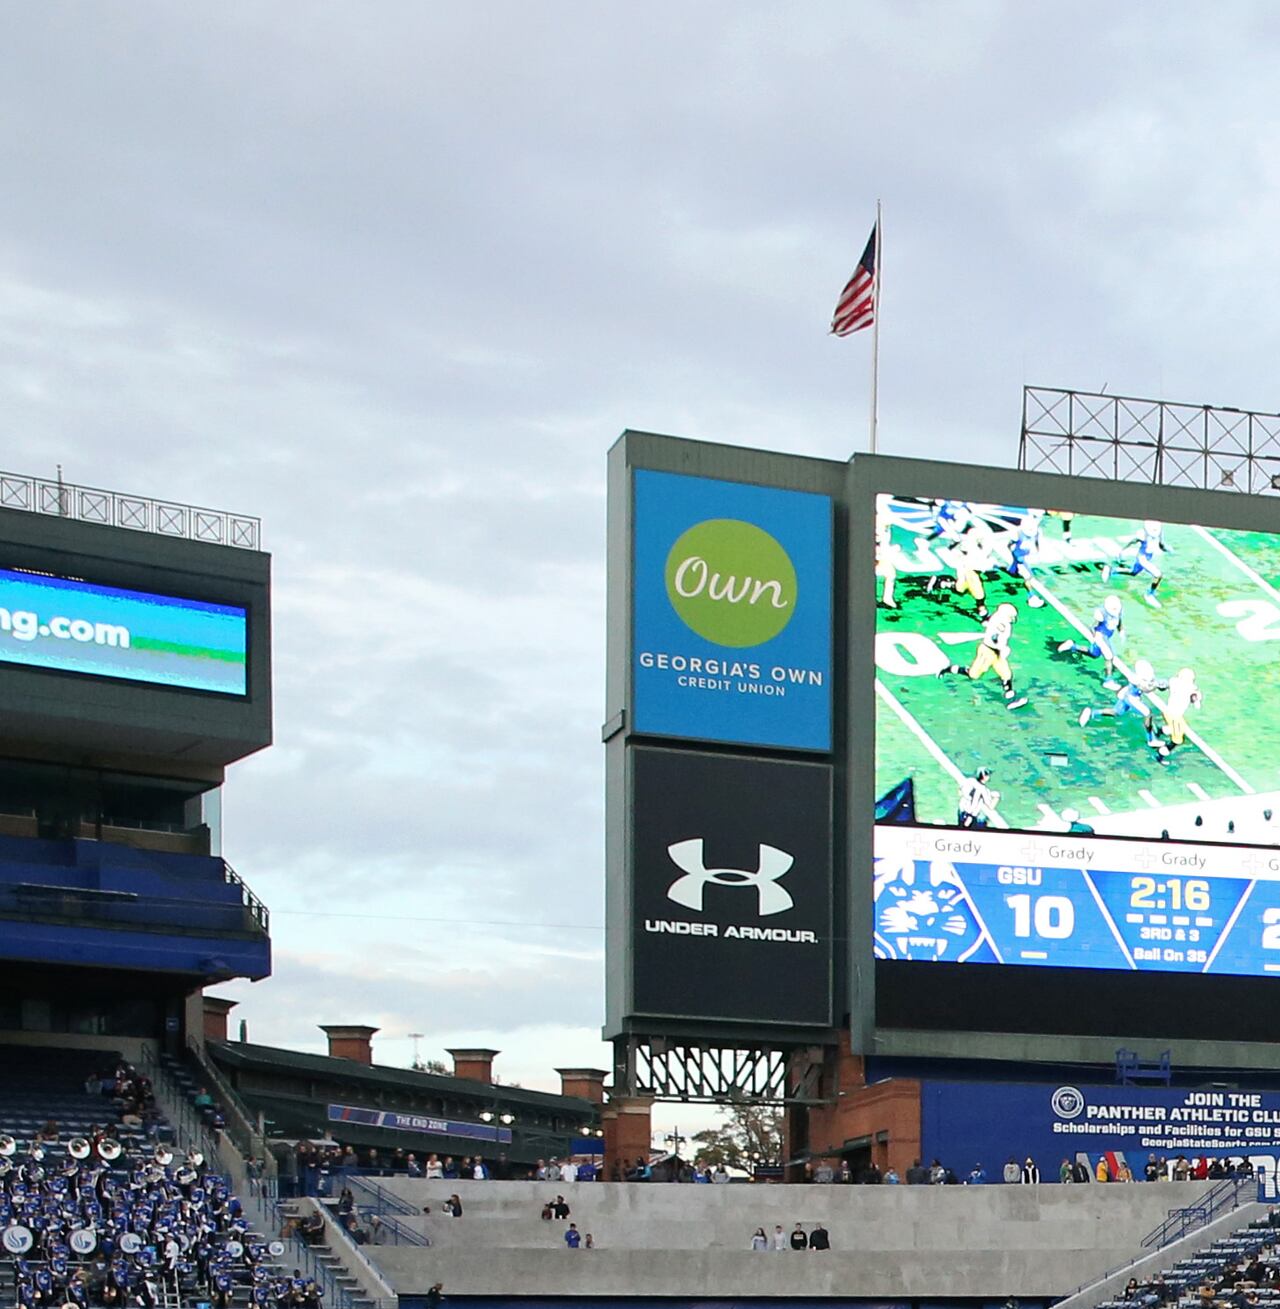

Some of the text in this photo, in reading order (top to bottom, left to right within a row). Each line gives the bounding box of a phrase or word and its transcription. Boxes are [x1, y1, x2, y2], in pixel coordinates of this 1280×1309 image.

[675, 556, 789, 608] Own
[640, 653, 823, 686] GEORGIA'S OWN
[678, 676, 785, 697] CREDIT UNION
[934, 838, 982, 857] Grady
[1048, 845, 1096, 863] Grady
[1161, 851, 1207, 870] Grady
[996, 866, 1042, 887] GSU
[1129, 876, 1211, 911] 2:16
[1006, 893, 1075, 939] 10
[645, 919, 718, 938] UNDER
[1140, 927, 1171, 944] 3RD
[1189, 930, 1200, 945] 3
[1164, 948, 1185, 964] On
[1184, 1093, 1261, 1107] JOIN THE
[1086, 1106, 1166, 1120] PANTHER
[1170, 1108, 1250, 1123] ATHLETIC
[1053, 1122, 1136, 1137] Scholarships
[1138, 1124, 1162, 1135] and
[1165, 1124, 1222, 1137] Facilities
[1225, 1126, 1243, 1137] for
[1245, 1127, 1271, 1138] GSU
